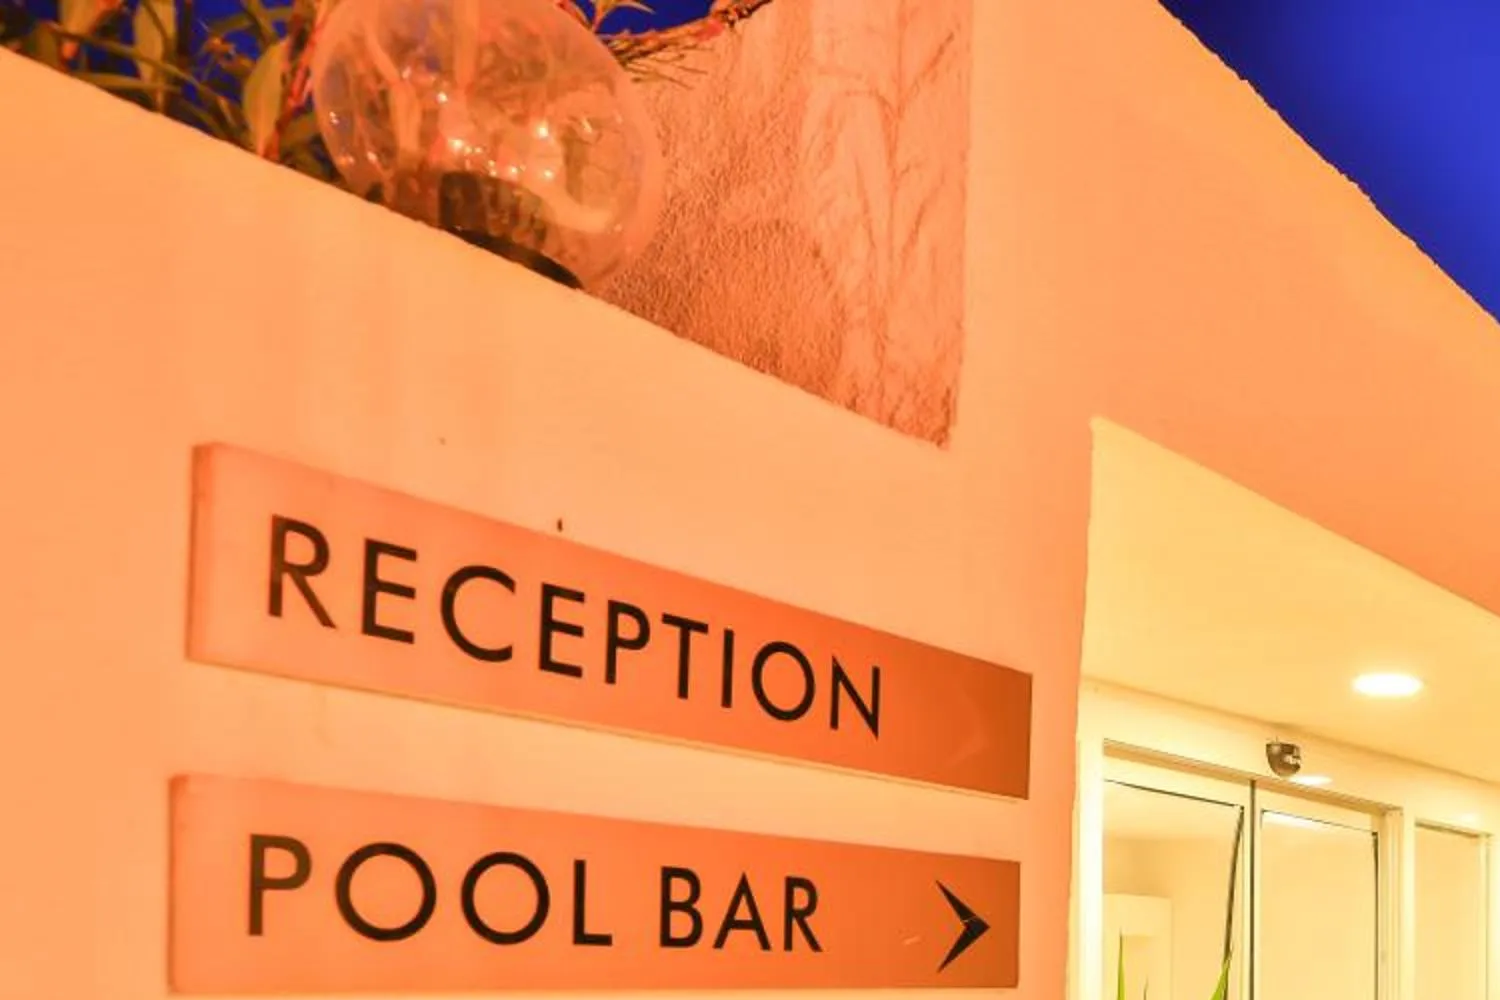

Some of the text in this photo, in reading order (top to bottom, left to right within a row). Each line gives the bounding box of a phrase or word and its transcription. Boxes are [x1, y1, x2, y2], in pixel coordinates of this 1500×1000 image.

[267, 514, 882, 740] RECEPTION
[247, 834, 824, 953] POOL BAR
